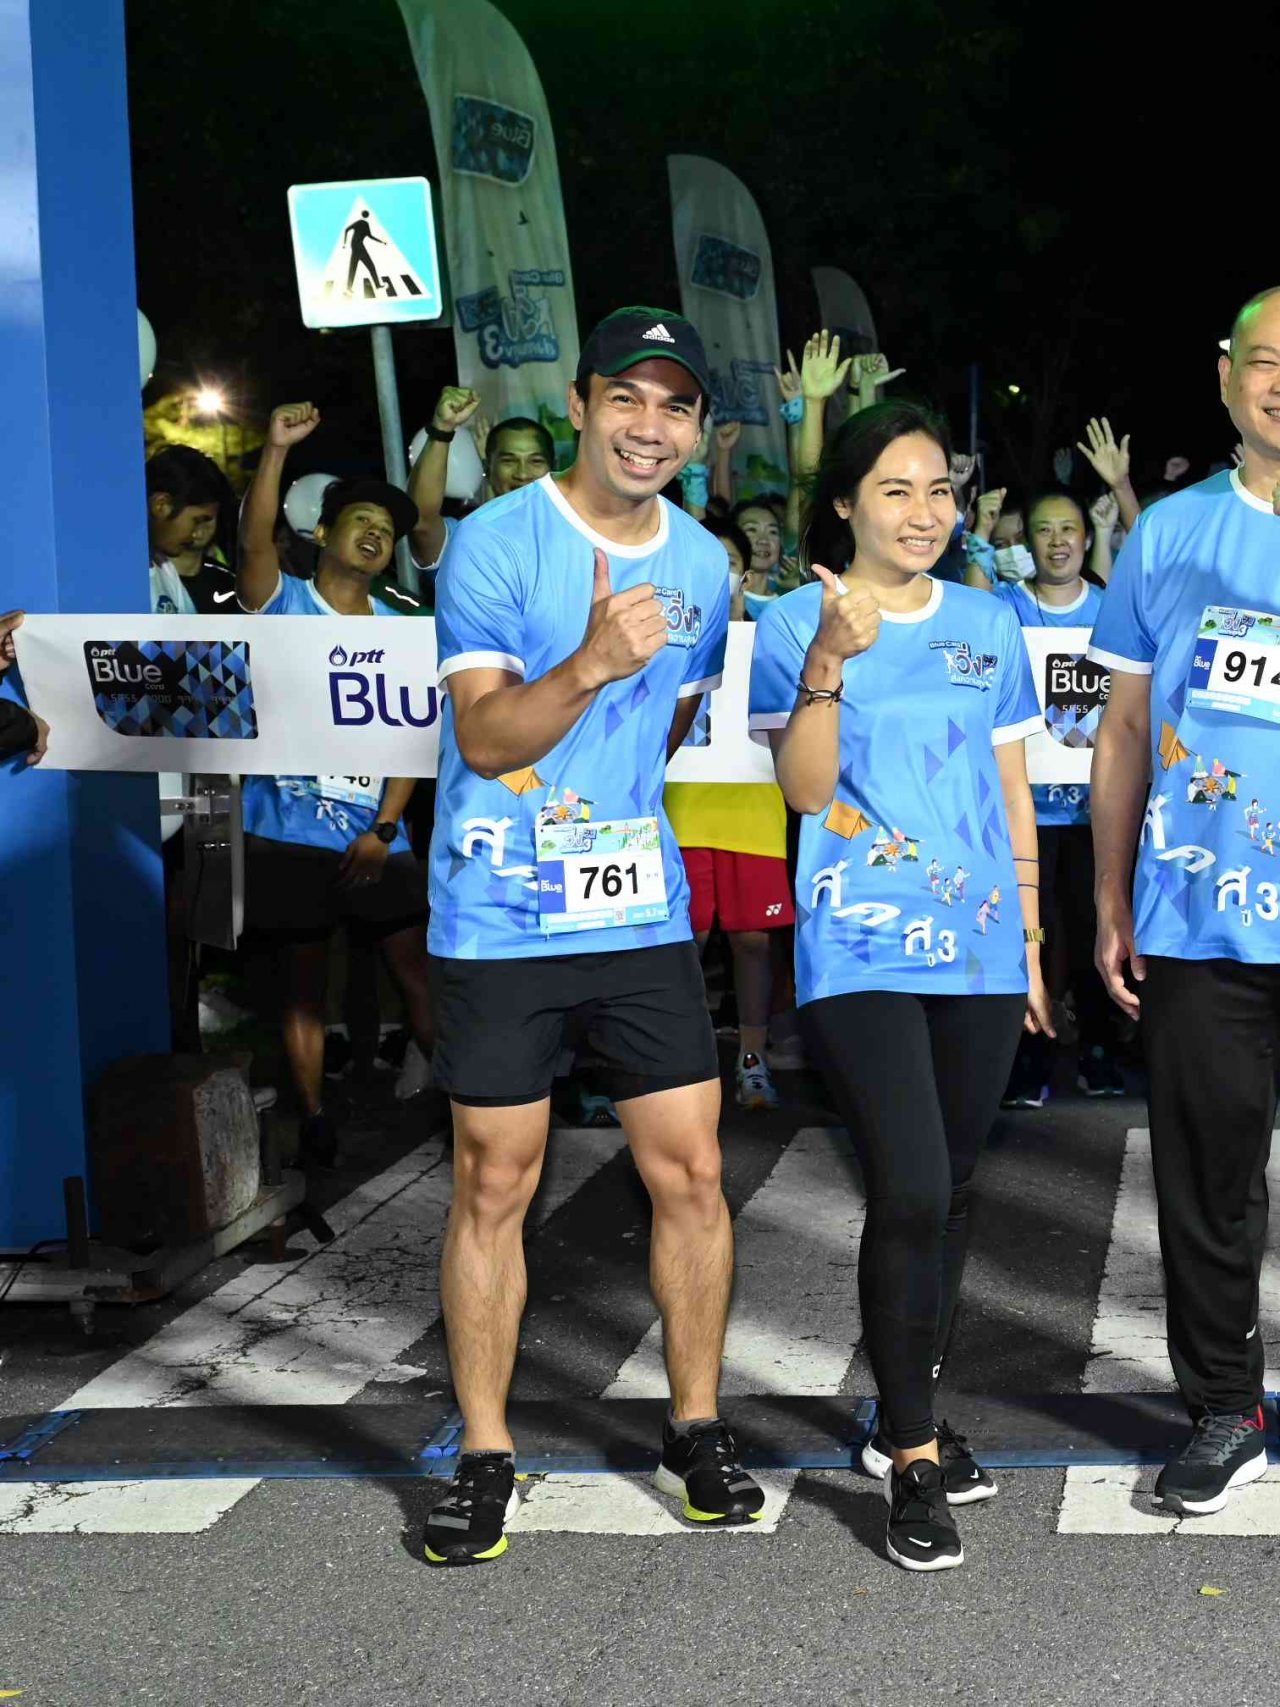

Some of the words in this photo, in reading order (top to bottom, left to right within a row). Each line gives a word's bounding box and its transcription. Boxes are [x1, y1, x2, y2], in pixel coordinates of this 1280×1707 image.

[100, 648, 117, 656] ptt
[350, 648, 386, 667] ptt
[92, 658, 162, 683] Blue
[1061, 661, 1077, 669] ptt
[1051, 669, 1111, 694] Blue
[328, 672, 444, 728] Blu
[579, 862, 639, 899] 761
